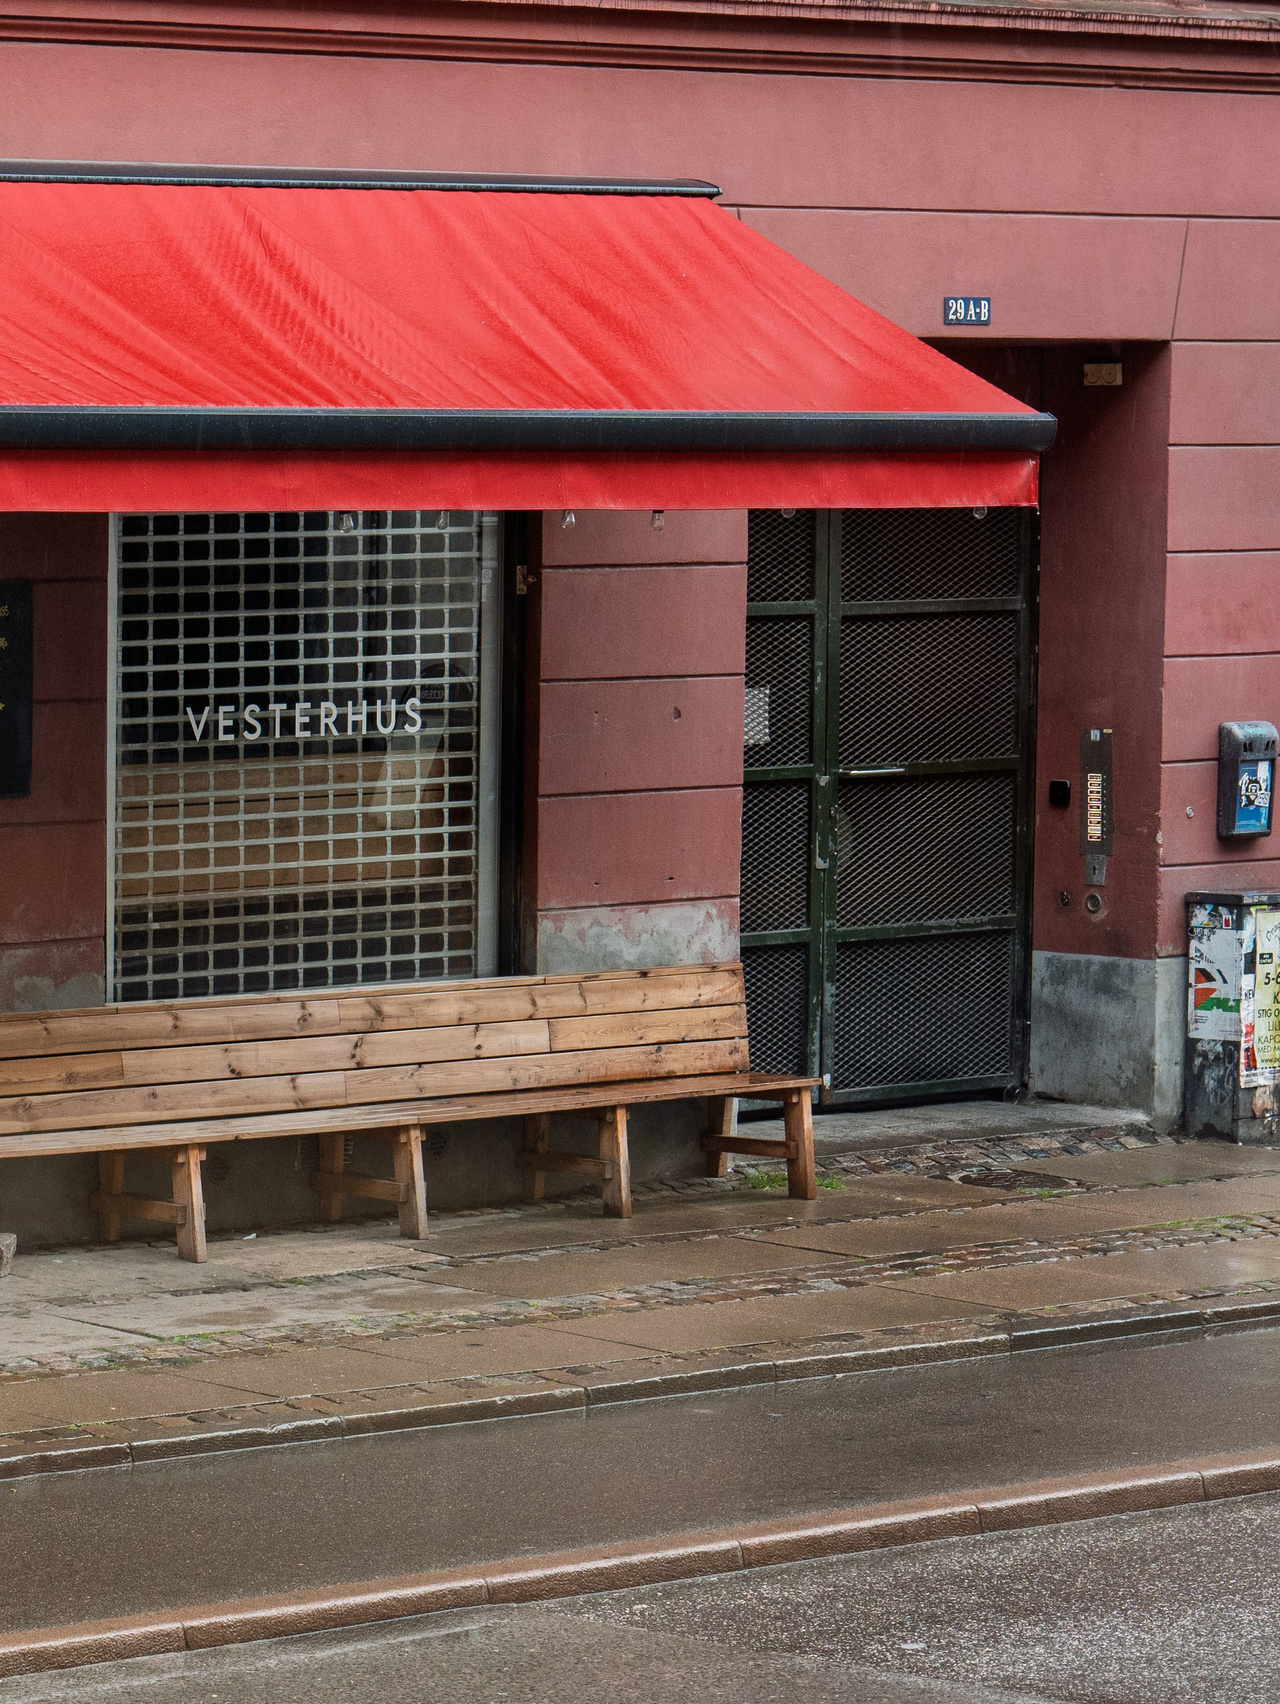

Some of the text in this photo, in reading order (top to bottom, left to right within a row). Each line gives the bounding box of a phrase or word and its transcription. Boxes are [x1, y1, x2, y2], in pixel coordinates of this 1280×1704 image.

[948, 299, 989, 321] 29 A-B
[185, 697, 422, 743] VESTERHUS
[1257, 1008, 1272, 1019] STIG
